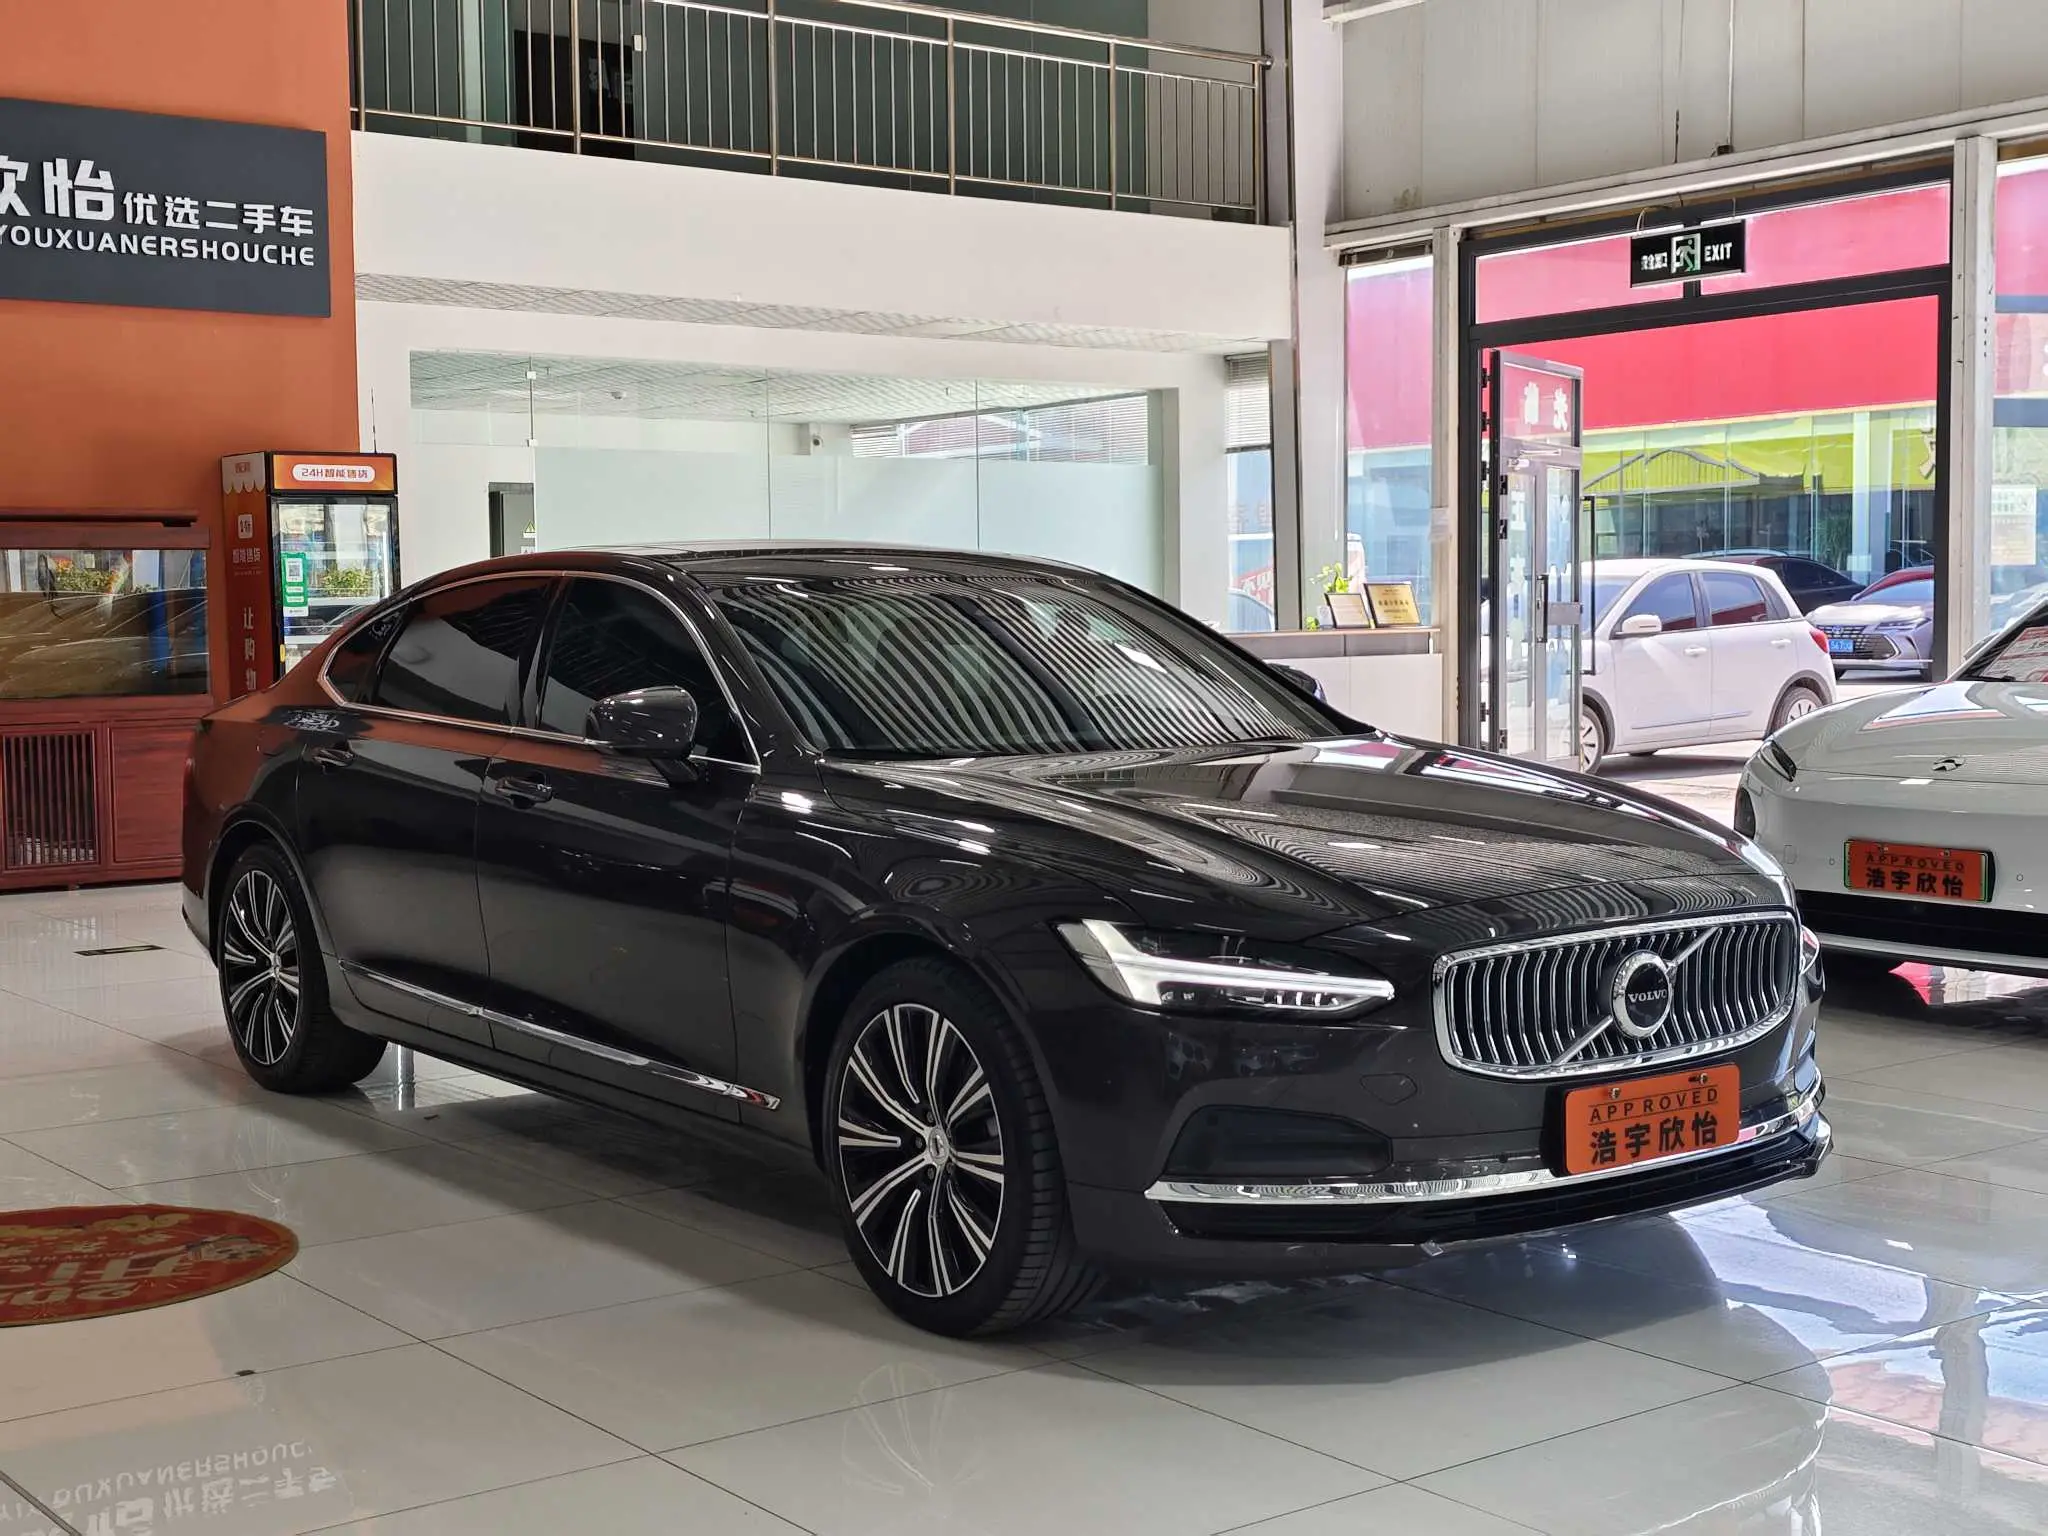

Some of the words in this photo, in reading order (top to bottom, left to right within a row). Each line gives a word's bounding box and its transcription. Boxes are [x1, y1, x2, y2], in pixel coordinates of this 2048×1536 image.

[123, 192, 314, 237] 优选二手车
[1704, 242, 1733, 262] EXIT
[1866, 851, 1965, 872] APPROVED
[1628, 989, 1668, 1003] VOLVO
[1590, 1088, 1718, 1123] APPROVED
